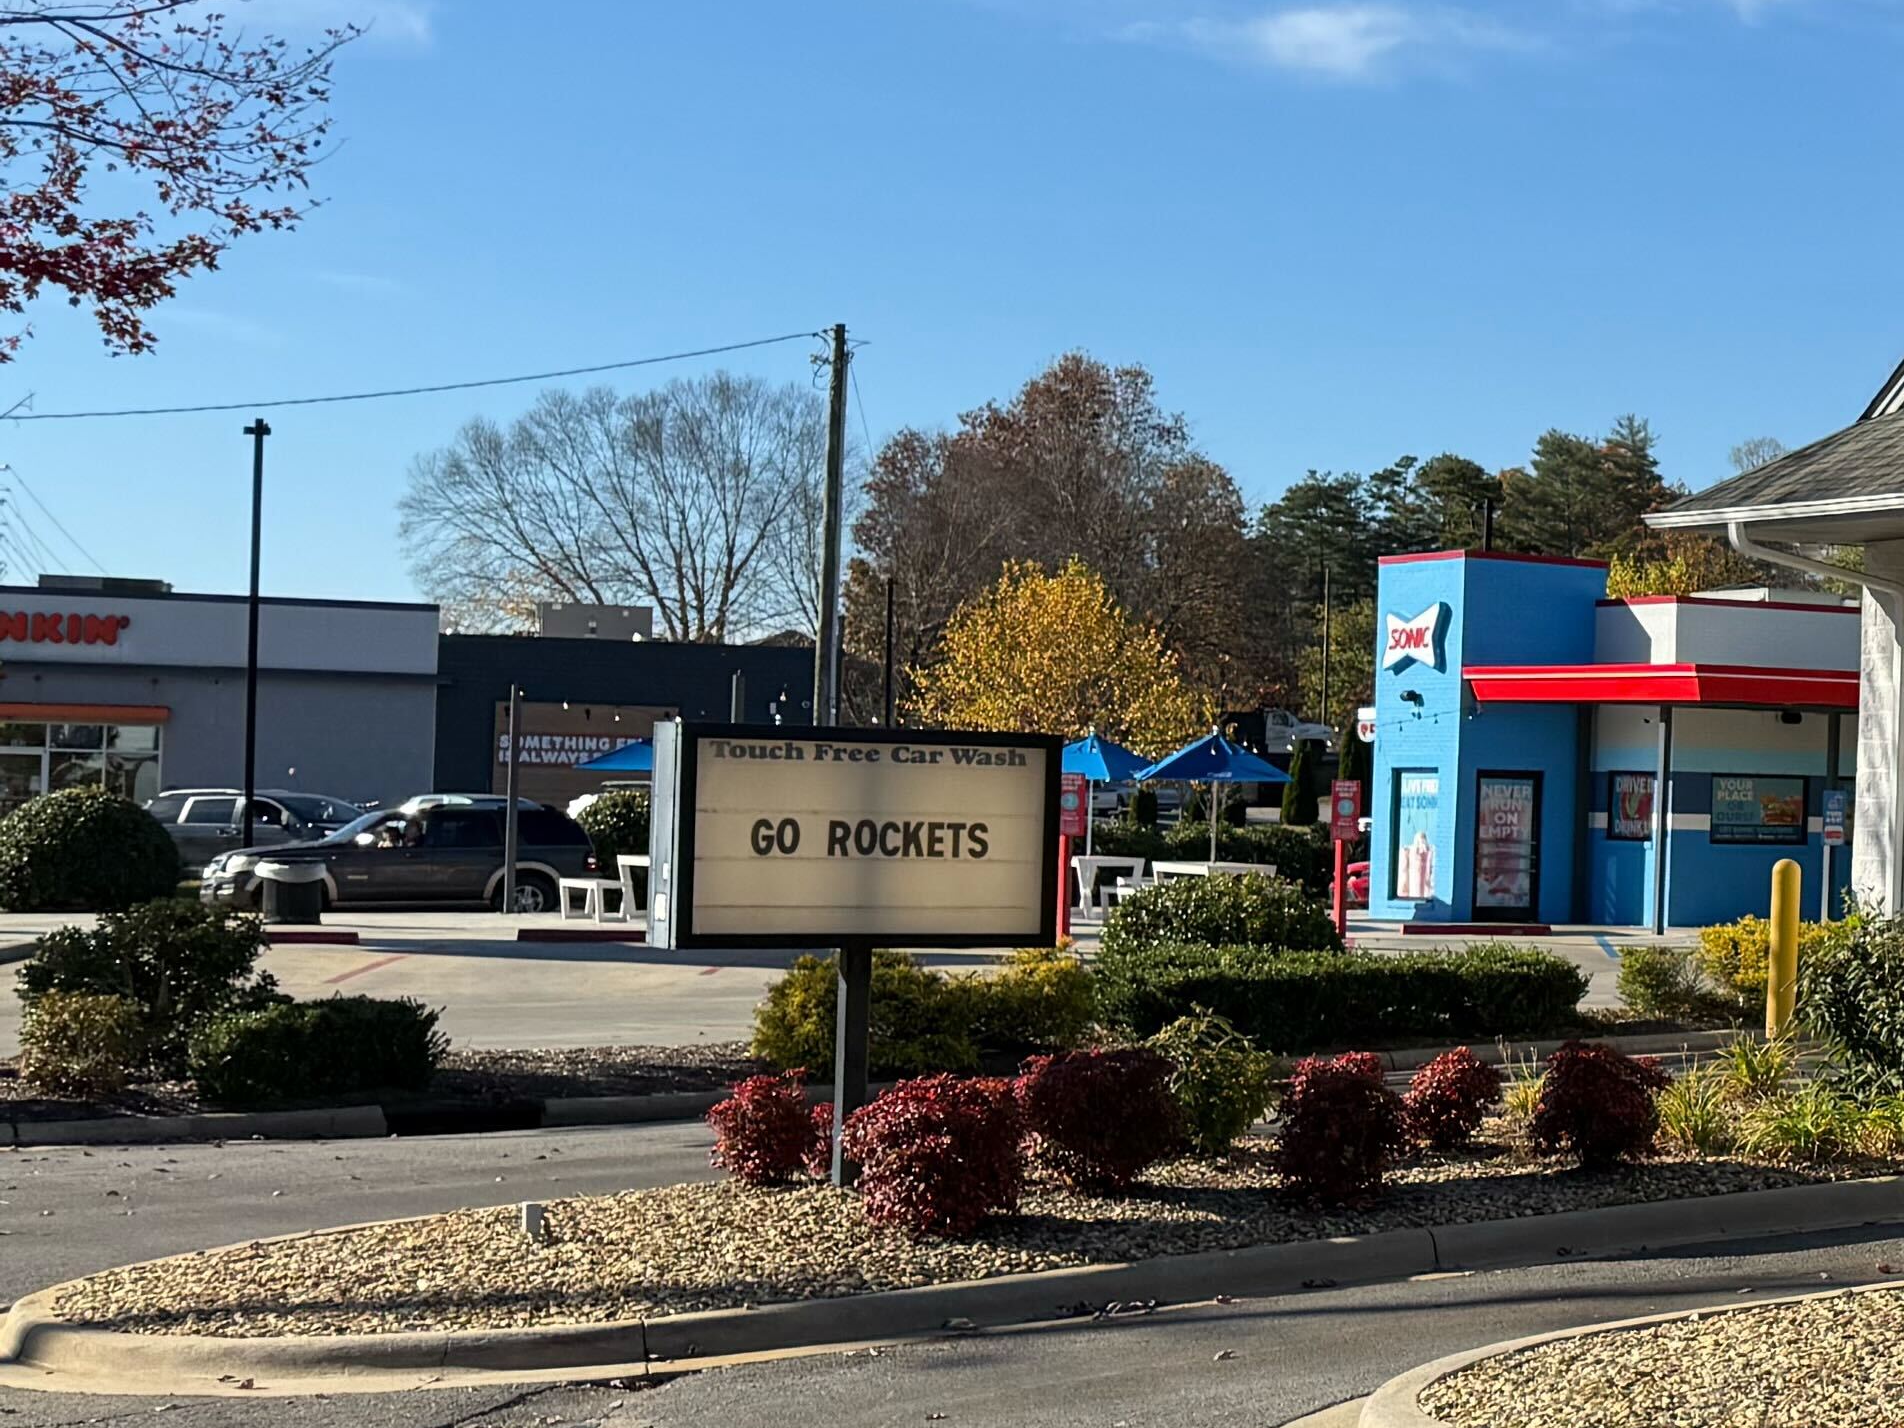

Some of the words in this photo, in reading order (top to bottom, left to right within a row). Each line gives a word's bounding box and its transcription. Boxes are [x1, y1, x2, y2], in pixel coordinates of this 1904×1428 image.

[1389, 626, 1430, 650] SONIC
[500, 735, 610, 750] SMETHING
[518, 751, 590, 764] ALWAYS
[710, 740, 804, 761] Touch
[813, 743, 880, 763] Free
[891, 746, 943, 764] Car
[949, 748, 1027, 767] Wash
[1481, 784, 1531, 799] NEVER
[1720, 779, 1753, 791] YOUR
[1717, 790, 1753, 801] PLACE
[1489, 798, 1521, 811] RUN
[1494, 812, 1518, 825] ON
[751, 818, 800, 856] GO
[827, 819, 989, 859] ROCKETS
[1480, 825, 1530, 839] EMPTY
